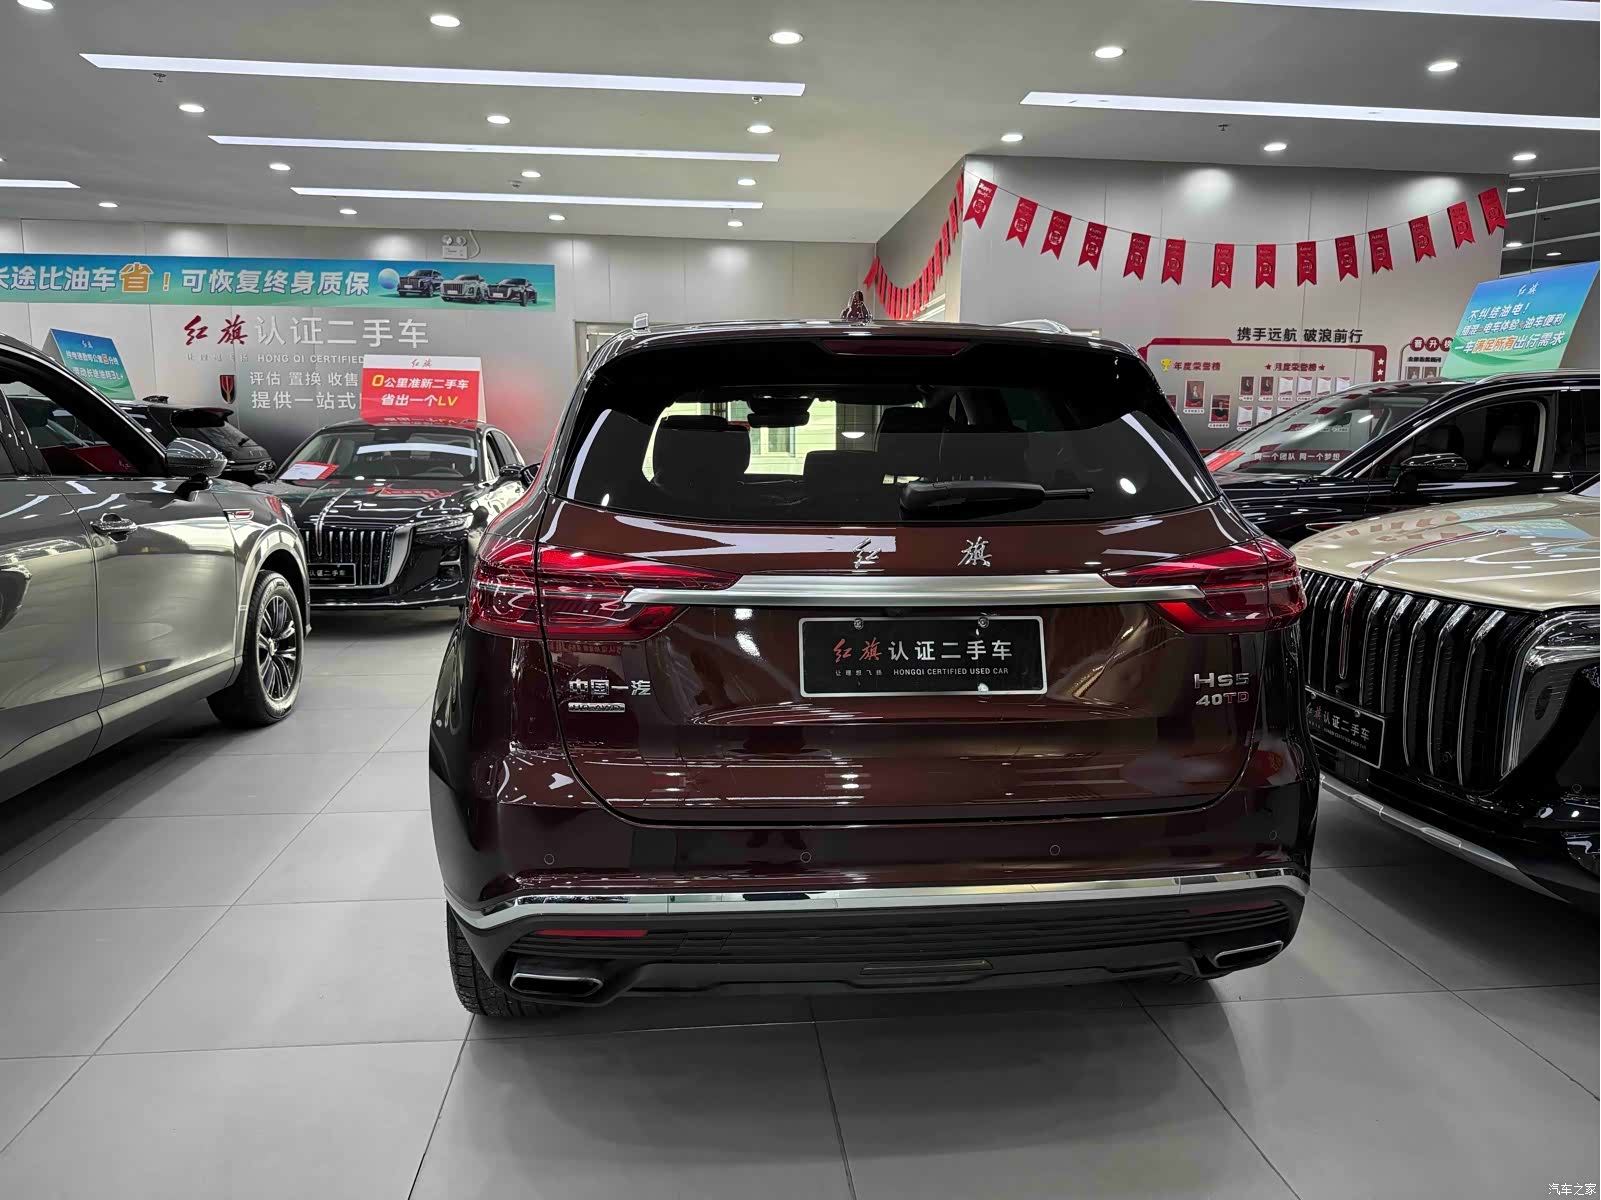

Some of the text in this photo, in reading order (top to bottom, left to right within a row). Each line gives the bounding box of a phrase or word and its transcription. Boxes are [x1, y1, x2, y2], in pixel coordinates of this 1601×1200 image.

[184, 314, 430, 349] 红旗认证二手车
[1237, 326, 1364, 344] 携手远航 破浪前行
[257, 354, 289, 363] HONG
[293, 354, 305, 363] QI
[310, 355, 364, 364] CERTIFIED
[250, 371, 359, 387] 评估 置换 收售
[371, 374, 470, 390] 0公里准新二手车
[251, 390, 362, 410] 提供一站式
[381, 393, 458, 407] 省出一个LV
[833, 637, 1013, 664] 红旗认证二手车
[893, 668, 925, 676] HONGQI
[927, 668, 967, 676] CERTIFIED
[970, 667, 990, 675] USED
[993, 667, 1009, 675] CAR
[568, 678, 652, 696] 中国一汽
[1193, 672, 1250, 689] HS5
[1195, 691, 1250, 707] 40TD
